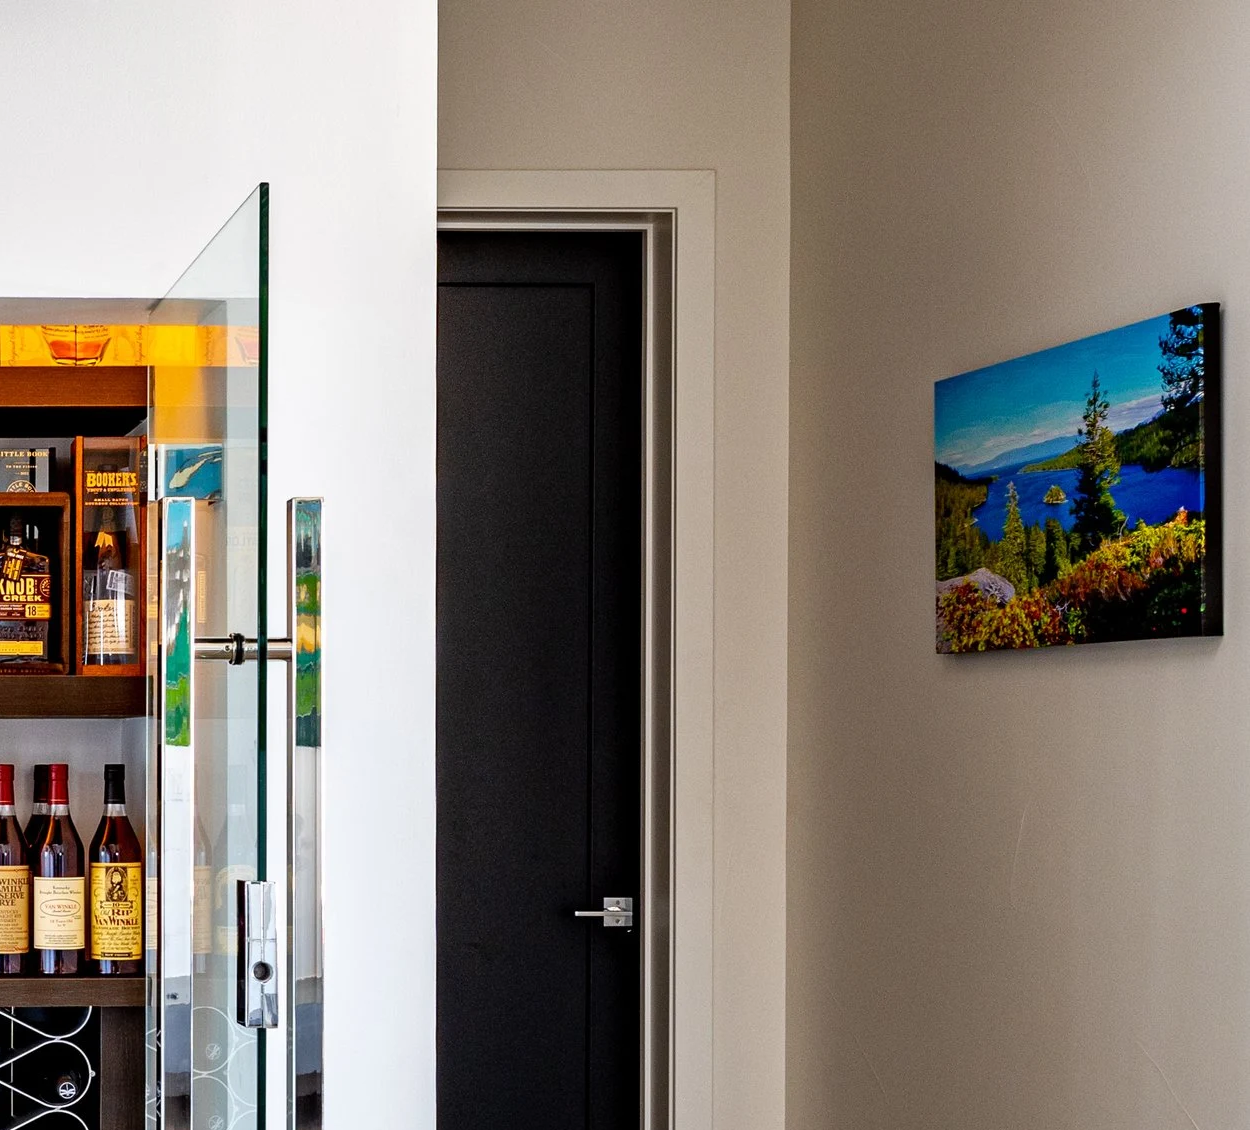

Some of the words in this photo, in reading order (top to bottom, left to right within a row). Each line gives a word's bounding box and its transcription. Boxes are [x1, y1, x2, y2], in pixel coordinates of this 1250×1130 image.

[86, 472, 137, 487] BOOKER'S
[27, 606, 37, 617] 18
[111, 908, 133, 916] RIP
[94, 914, 109, 926] VAN
[108, 914, 139, 926] WINKLE
